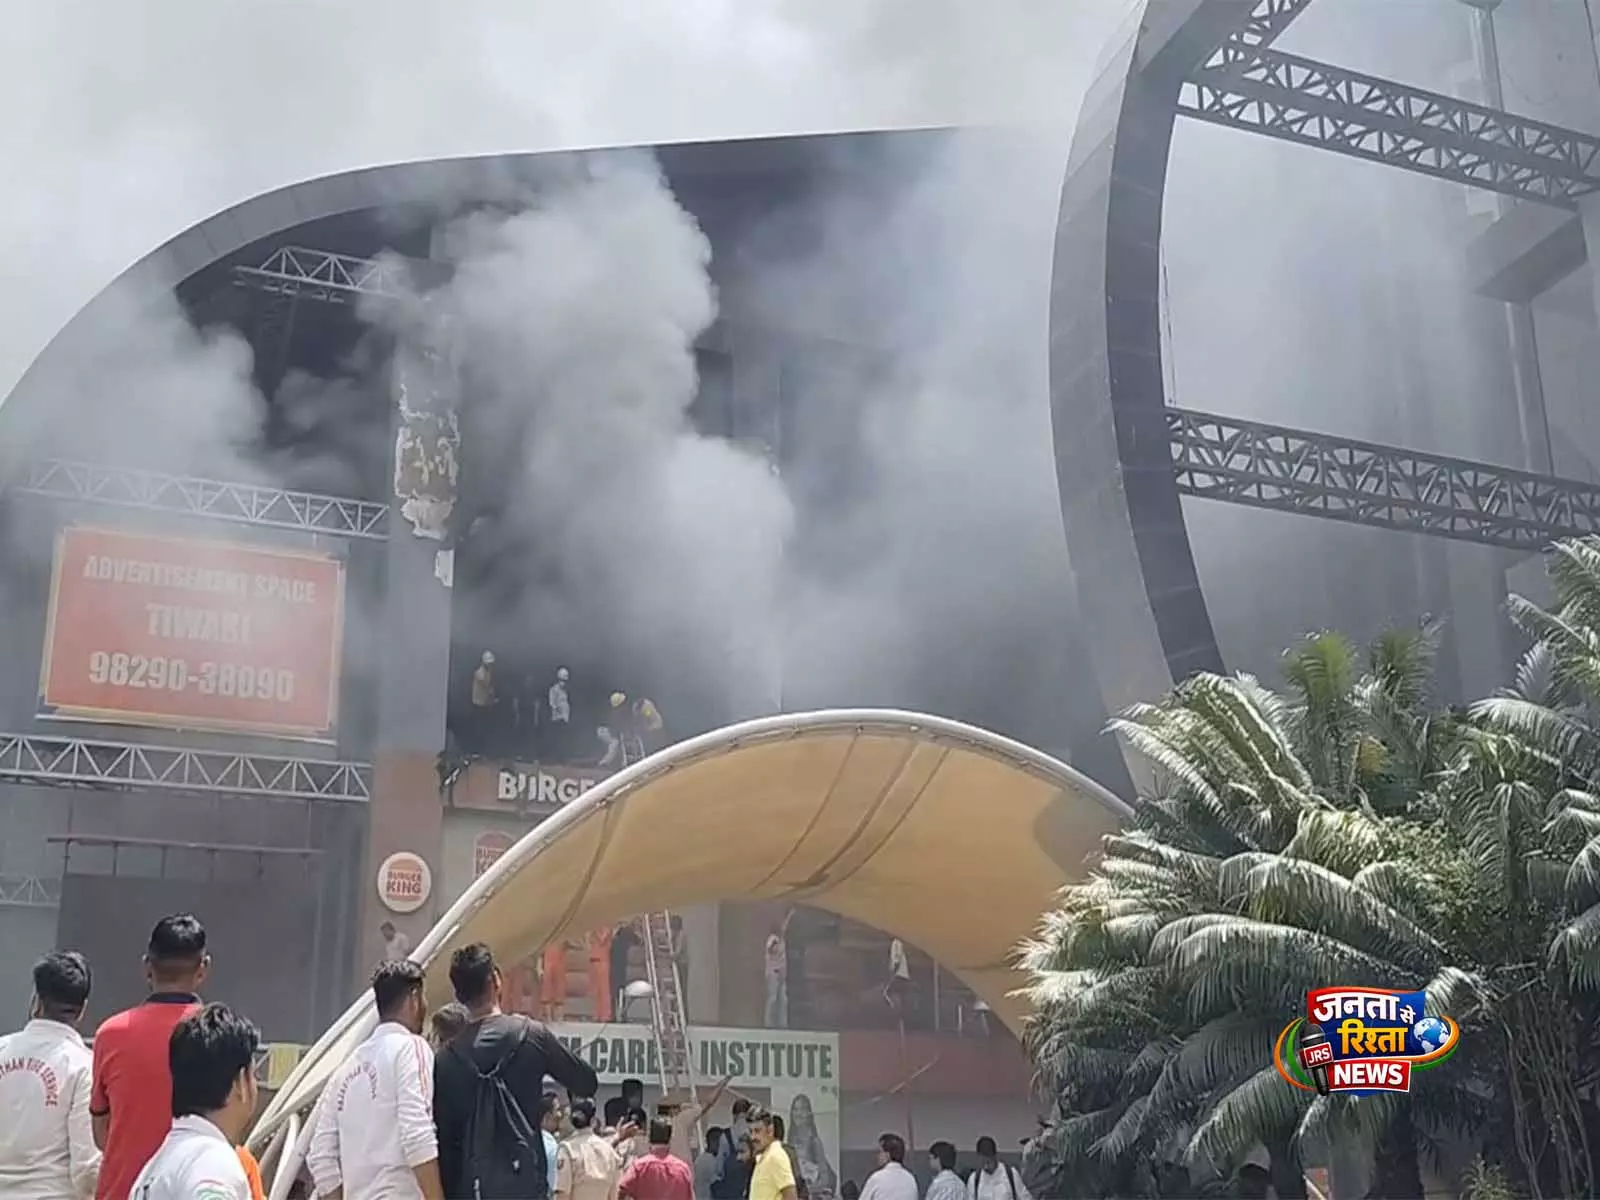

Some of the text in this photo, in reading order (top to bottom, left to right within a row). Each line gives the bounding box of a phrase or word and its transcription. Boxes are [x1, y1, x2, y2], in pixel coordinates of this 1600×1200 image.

[83, 555, 316, 602] ADVERTISEMENT SPACE
[145, 602, 251, 644] TIWARI
[89, 652, 294, 700] 98290-38090
[386, 879, 421, 894] KING
[387, 871, 421, 881] BURGER
[700, 1040, 833, 1079] INSTITUTE
